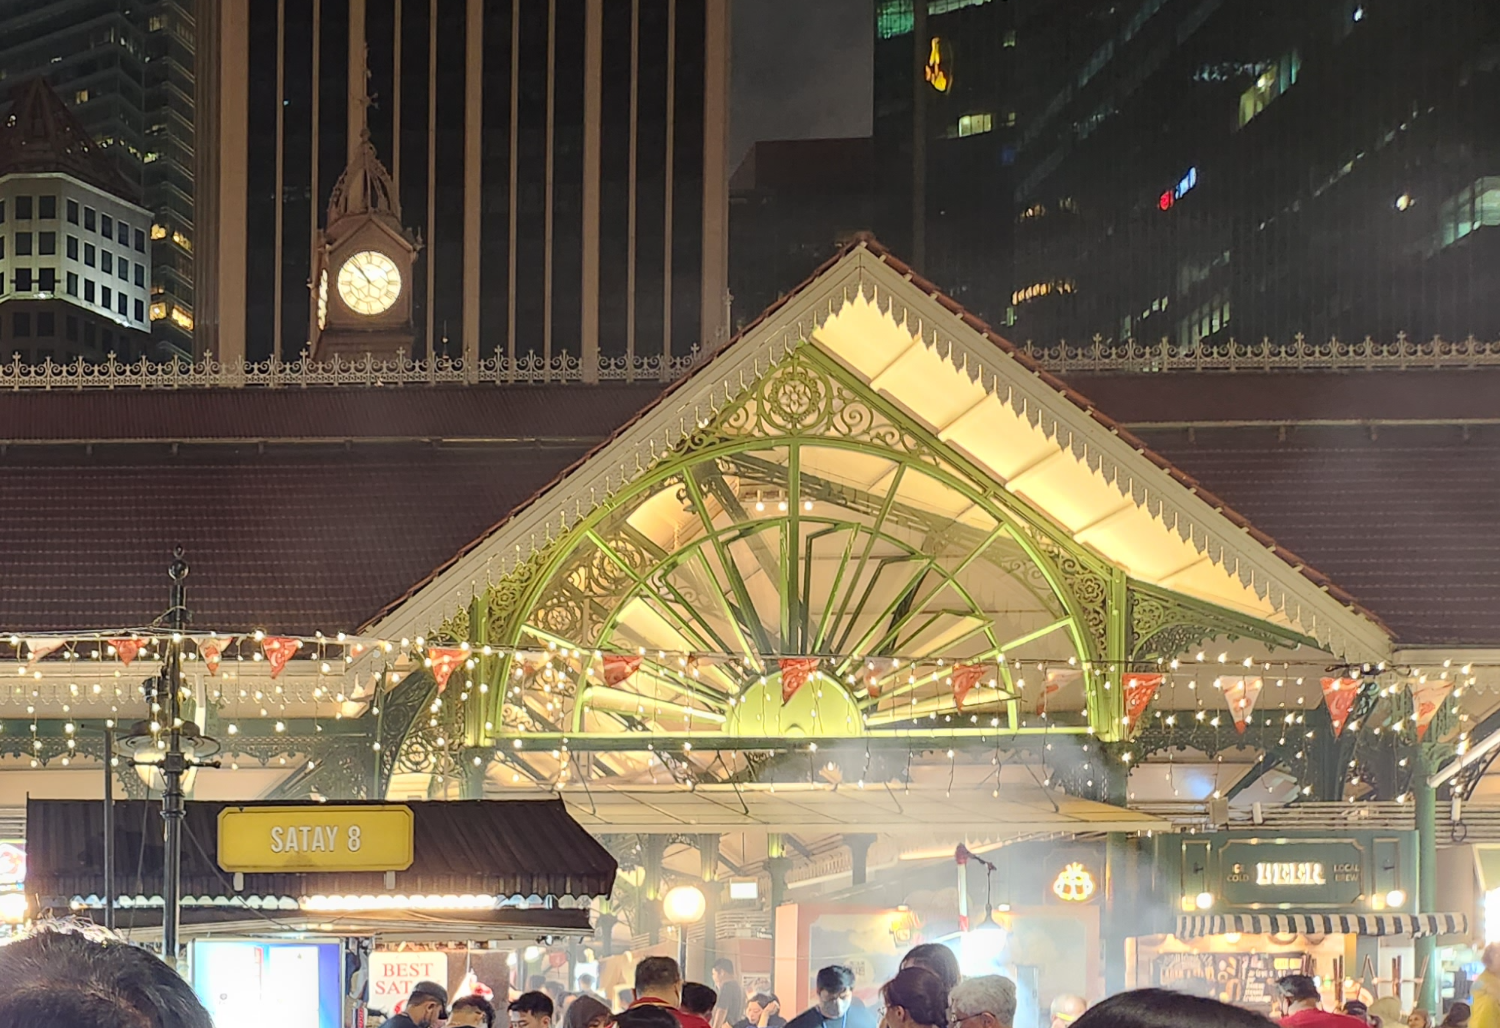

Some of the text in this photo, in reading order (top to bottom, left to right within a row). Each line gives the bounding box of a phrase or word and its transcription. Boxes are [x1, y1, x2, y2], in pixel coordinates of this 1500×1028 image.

[270, 825, 361, 852] SATAY 8
[1333, 864, 1360, 873] LOCAL
[382, 963, 434, 977] BEST
[375, 980, 413, 995] SAT
